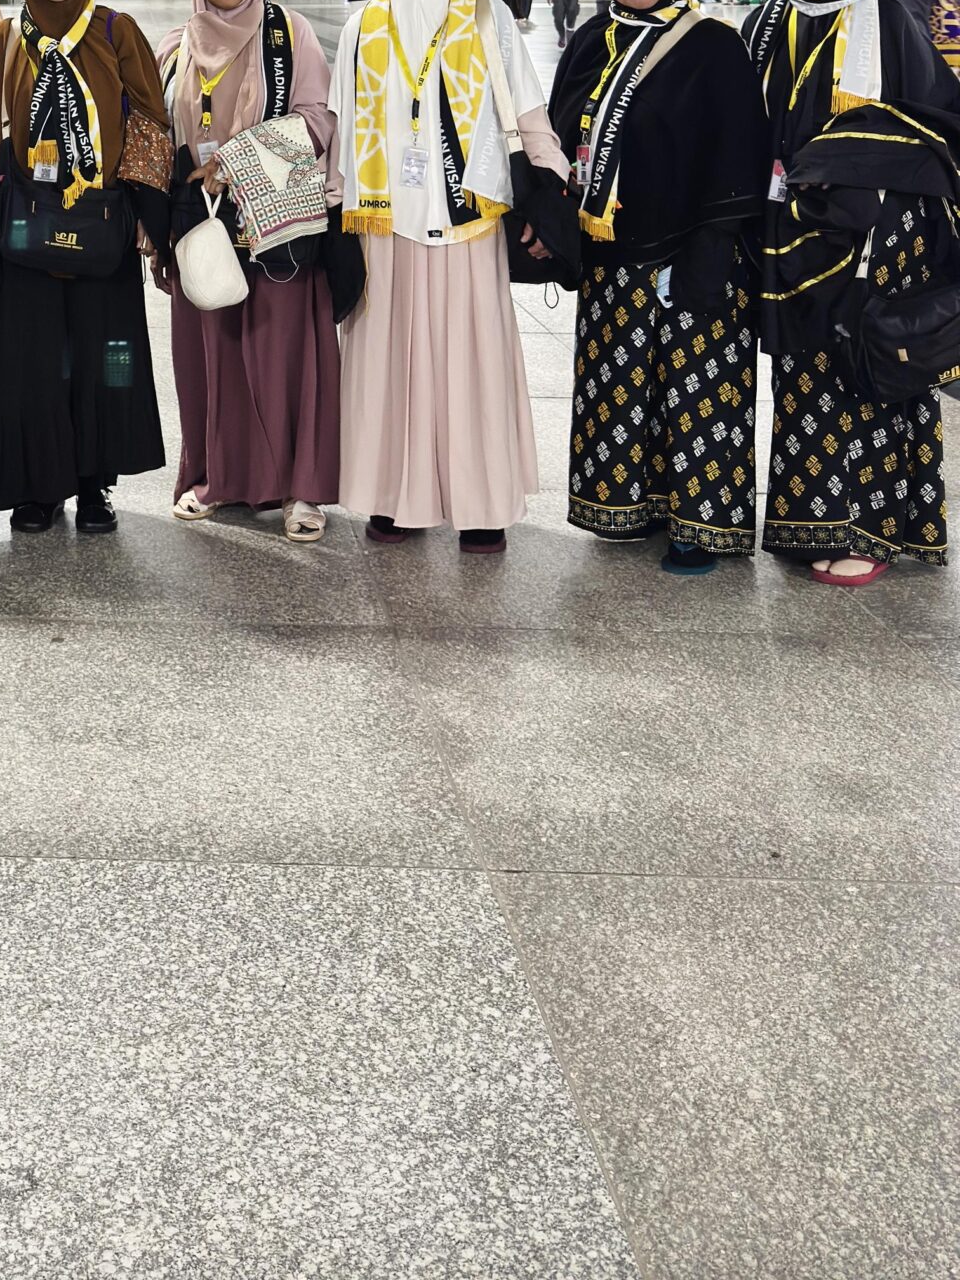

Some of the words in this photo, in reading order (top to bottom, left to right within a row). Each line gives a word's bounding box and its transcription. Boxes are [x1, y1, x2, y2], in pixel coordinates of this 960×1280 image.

[757, 27, 774, 60] IMAN
[57, 74, 68, 108] IMAN
[272, 57, 284, 118] MADINAH
[621, 55, 647, 107] DINAH
[60, 112, 74, 170] ADINAH
[75, 121, 94, 167] WISATA
[603, 106, 625, 144] IMAN
[443, 155, 465, 208] WISATA
